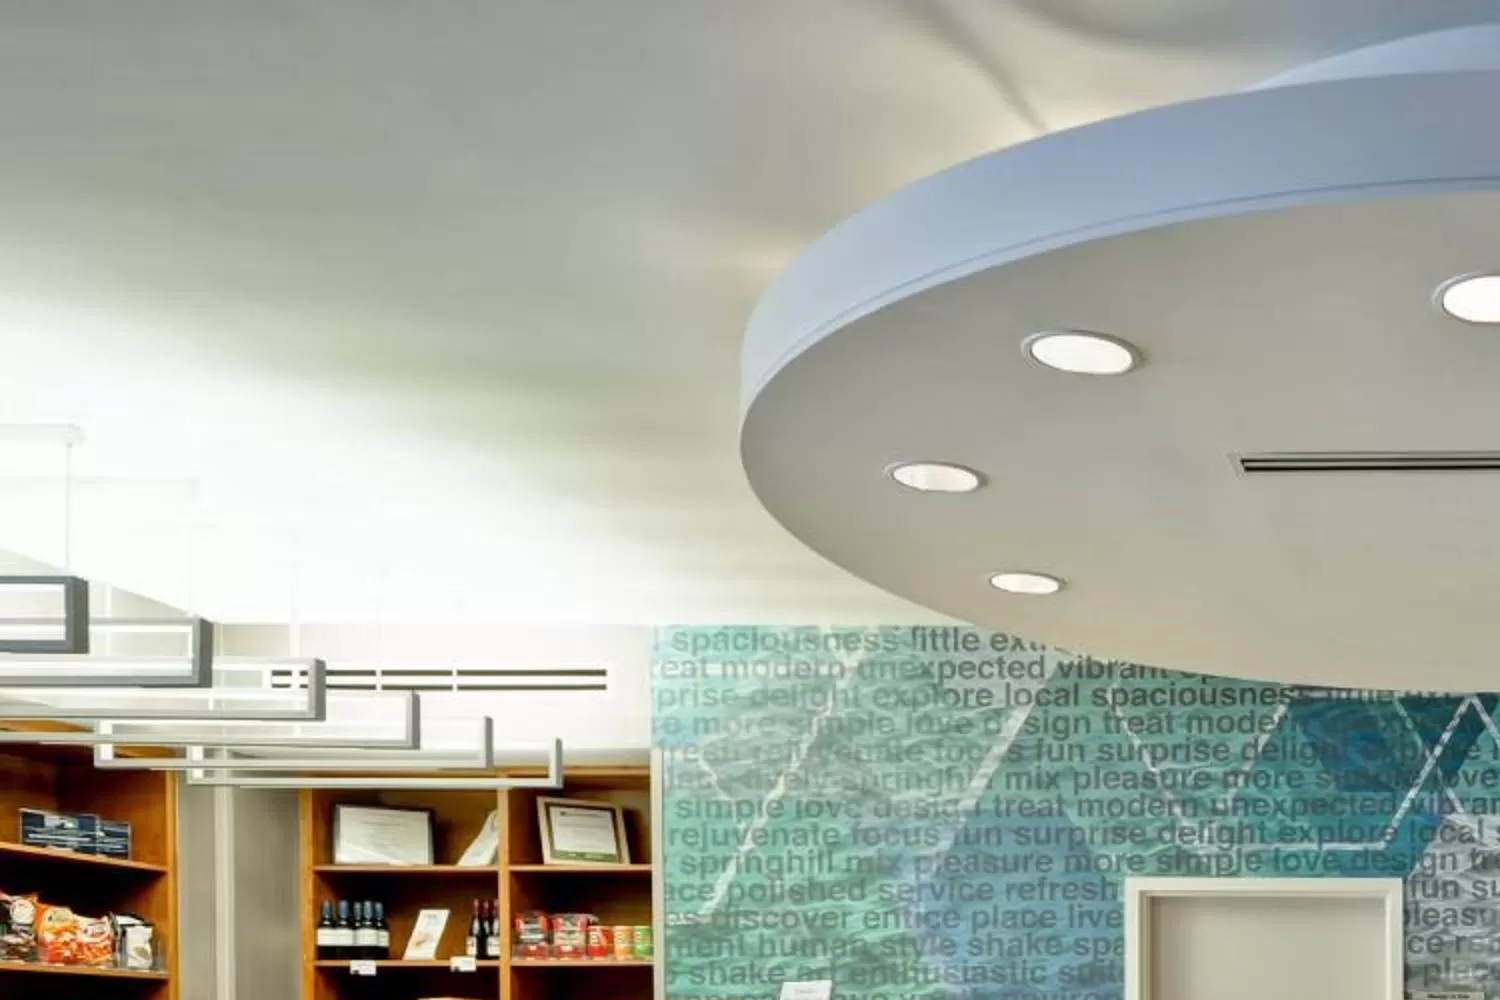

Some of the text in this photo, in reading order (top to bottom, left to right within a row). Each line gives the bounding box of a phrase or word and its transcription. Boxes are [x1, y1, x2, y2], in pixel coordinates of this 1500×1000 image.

[672, 628, 898, 658] spaciousness
[913, 628, 980, 652] little
[722, 655, 845, 679] modern
[858, 655, 1045, 685] unexpected
[751, 683, 860, 713] delight
[873, 683, 993, 713] explore
[1005, 682, 1079, 706] local
[693, 716, 779, 734] more
[908, 710, 974, 734] love
[1103, 711, 1175, 733] treat
[1187, 709, 1308, 733] modern
[1038, 738, 1085, 762] fun
[1096, 738, 1230, 768] surprise
[1006, 765, 1060, 789] mix
[1074, 765, 1213, 795] pleasure
[1224, 771, 1305, 789] more
[677, 794, 785, 824] simple
[795, 794, 862, 818] love
[992, 795, 1065, 817] treat
[1077, 793, 1199, 817] modern
[1210, 792, 1402, 822] unexpected
[668, 822, 840, 852] rejuvenate
[851, 821, 938, 845] focus
[1015, 821, 1146, 851] surprise
[1157, 820, 1272, 850] delight
[1284, 819, 1398, 849] explore
[1410, 819, 1484, 843] local
[681, 849, 833, 879] springhill
[915, 848, 1053, 878] pleasure
[1064, 853, 1145, 871] more
[1156, 847, 1261, 877] simple
[1274, 846, 1338, 870] love
[1352, 846, 1457, 876] design
[727, 877, 866, 907] polished
[879, 876, 994, 900] service
[1006, 876, 1117, 900] refresh
[1410, 874, 1460, 898] fun
[712, 904, 848, 928] discover
[863, 904, 960, 928] entice
[971, 903, 1056, 933] place
[760, 932, 867, 956] human
[880, 932, 956, 962] style
[967, 931, 1062, 955] shake
[690, 960, 785, 984] shake
[848, 959, 1046, 983] enthusiastic
